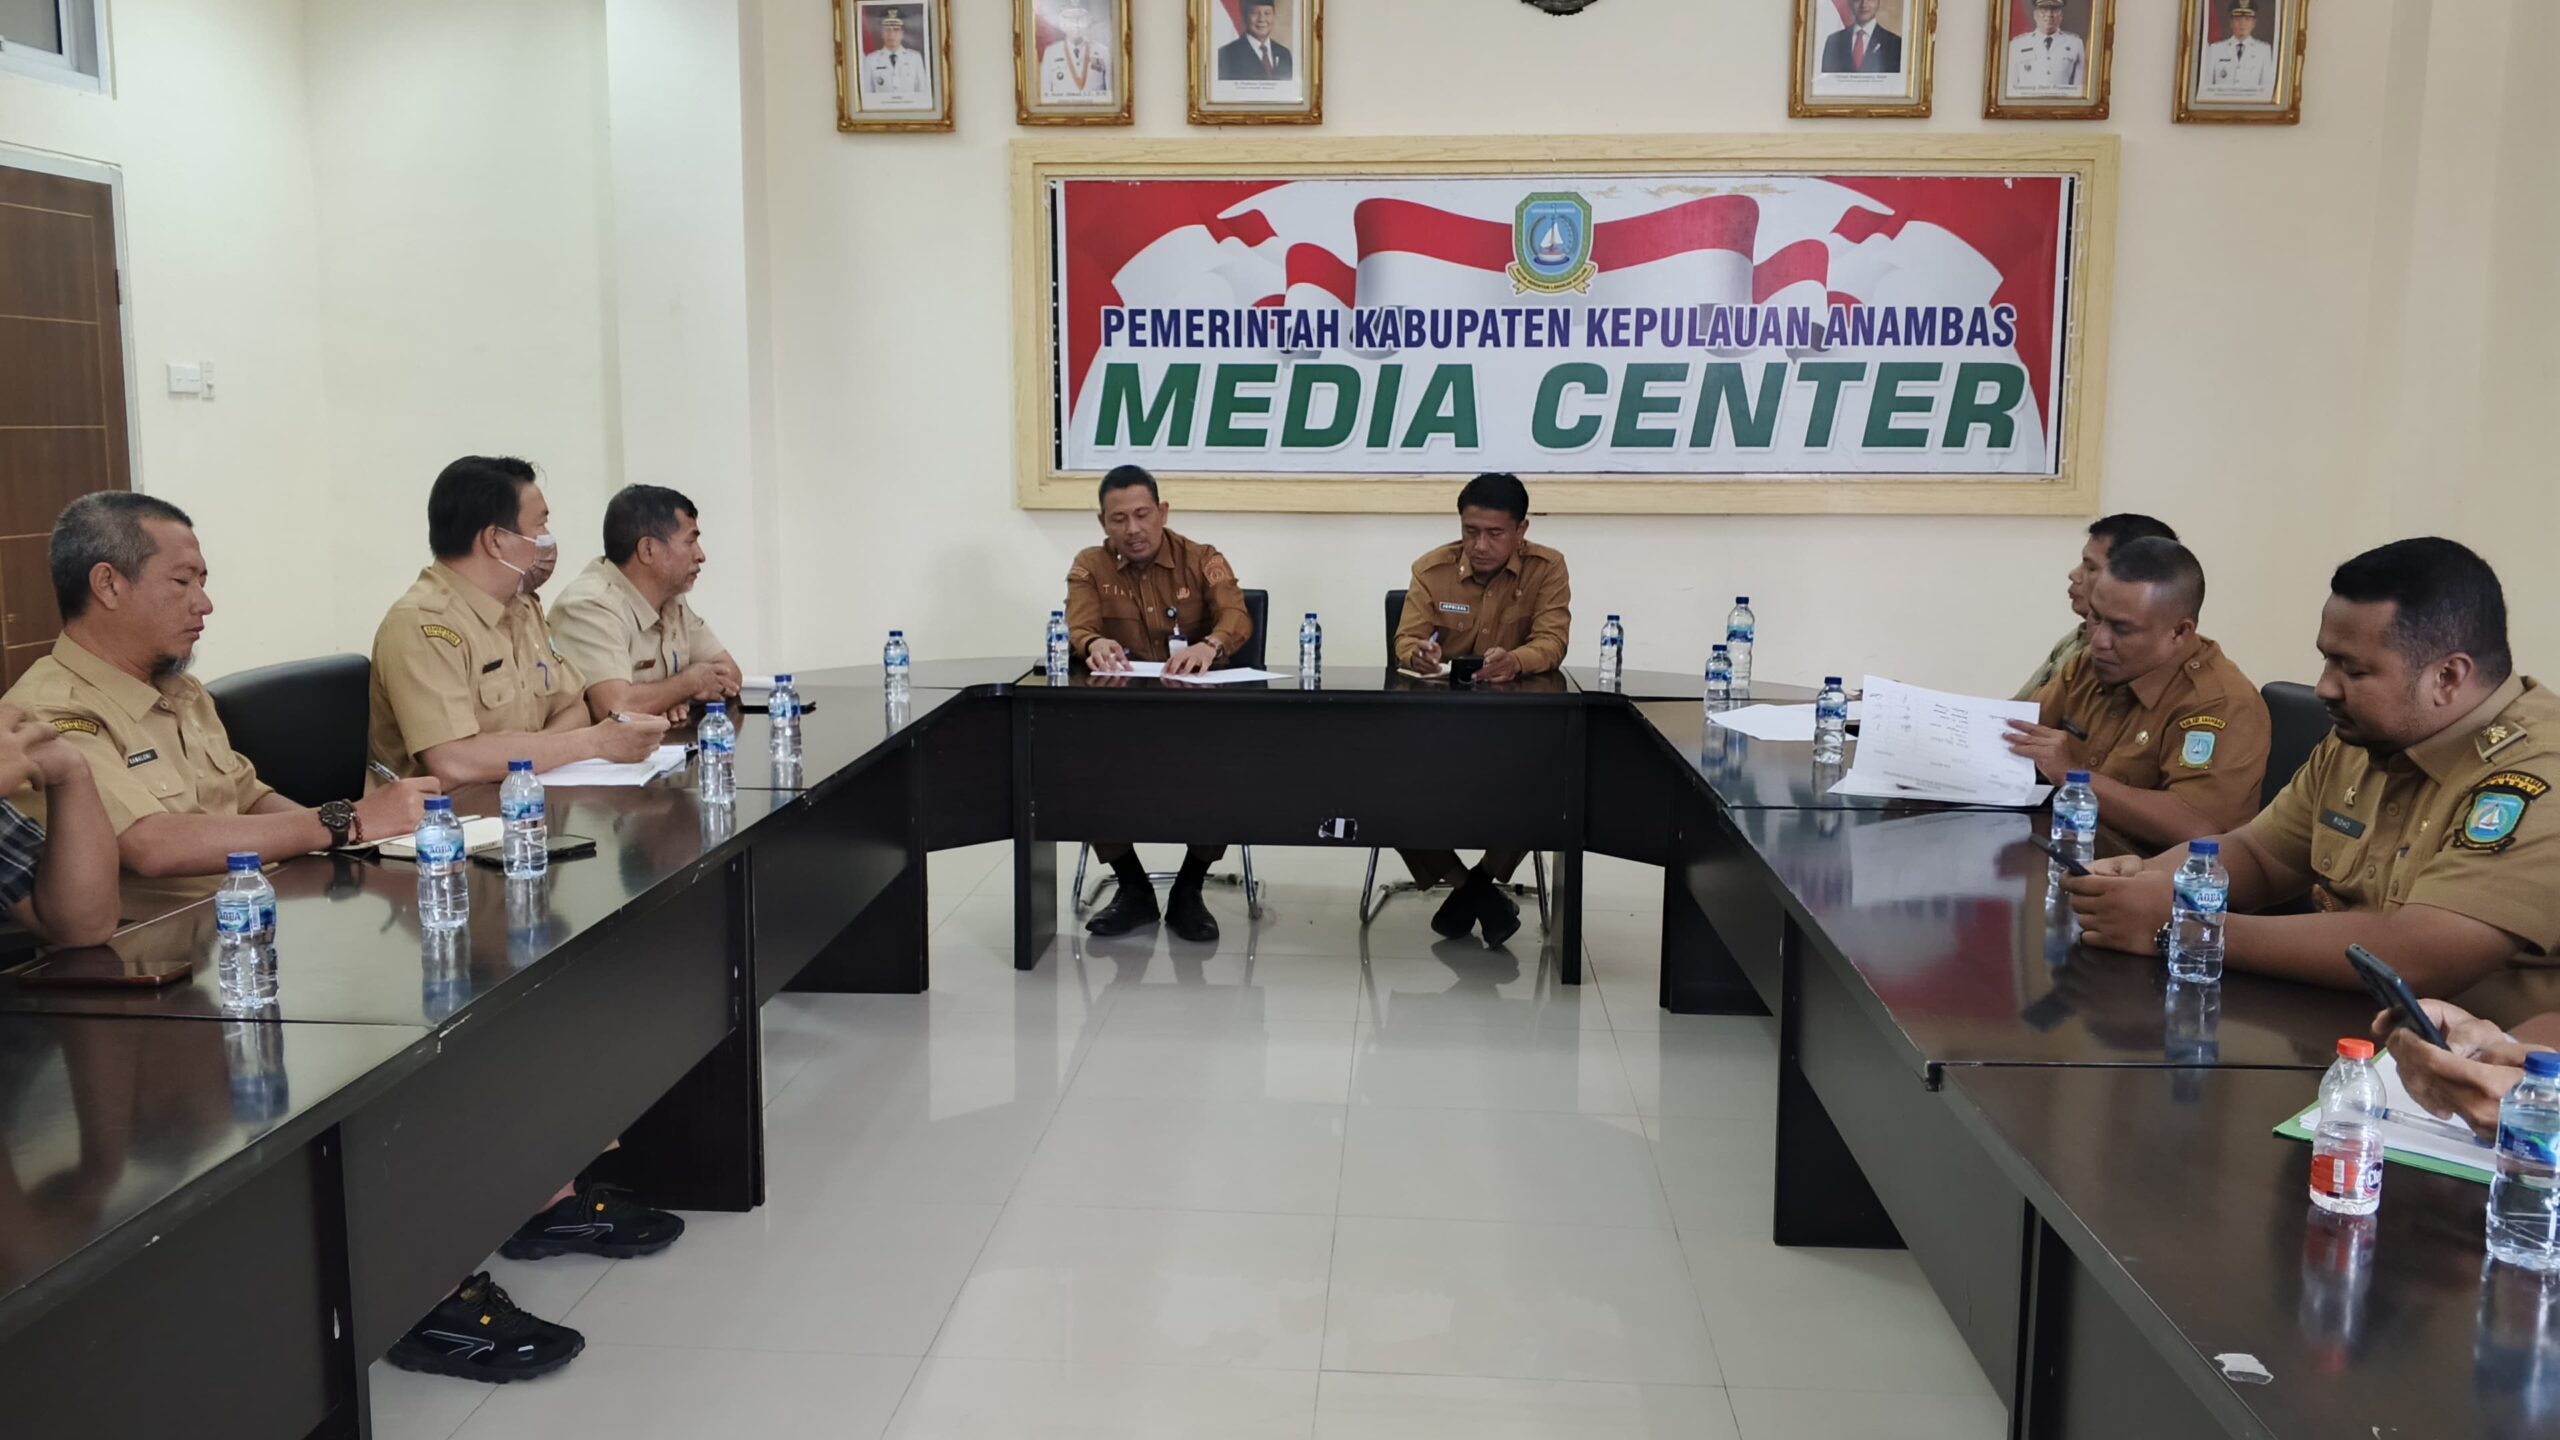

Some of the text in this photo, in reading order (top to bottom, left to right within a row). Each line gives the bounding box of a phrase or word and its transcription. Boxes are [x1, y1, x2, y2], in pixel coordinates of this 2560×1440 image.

[1103, 306, 2015, 348] PEMERINTAH KABUPATEN KEPULAUAN ANAMBAS
[1093, 361, 2026, 449] MEDIA CENTER
[2196, 892, 2223, 902] AQUA
